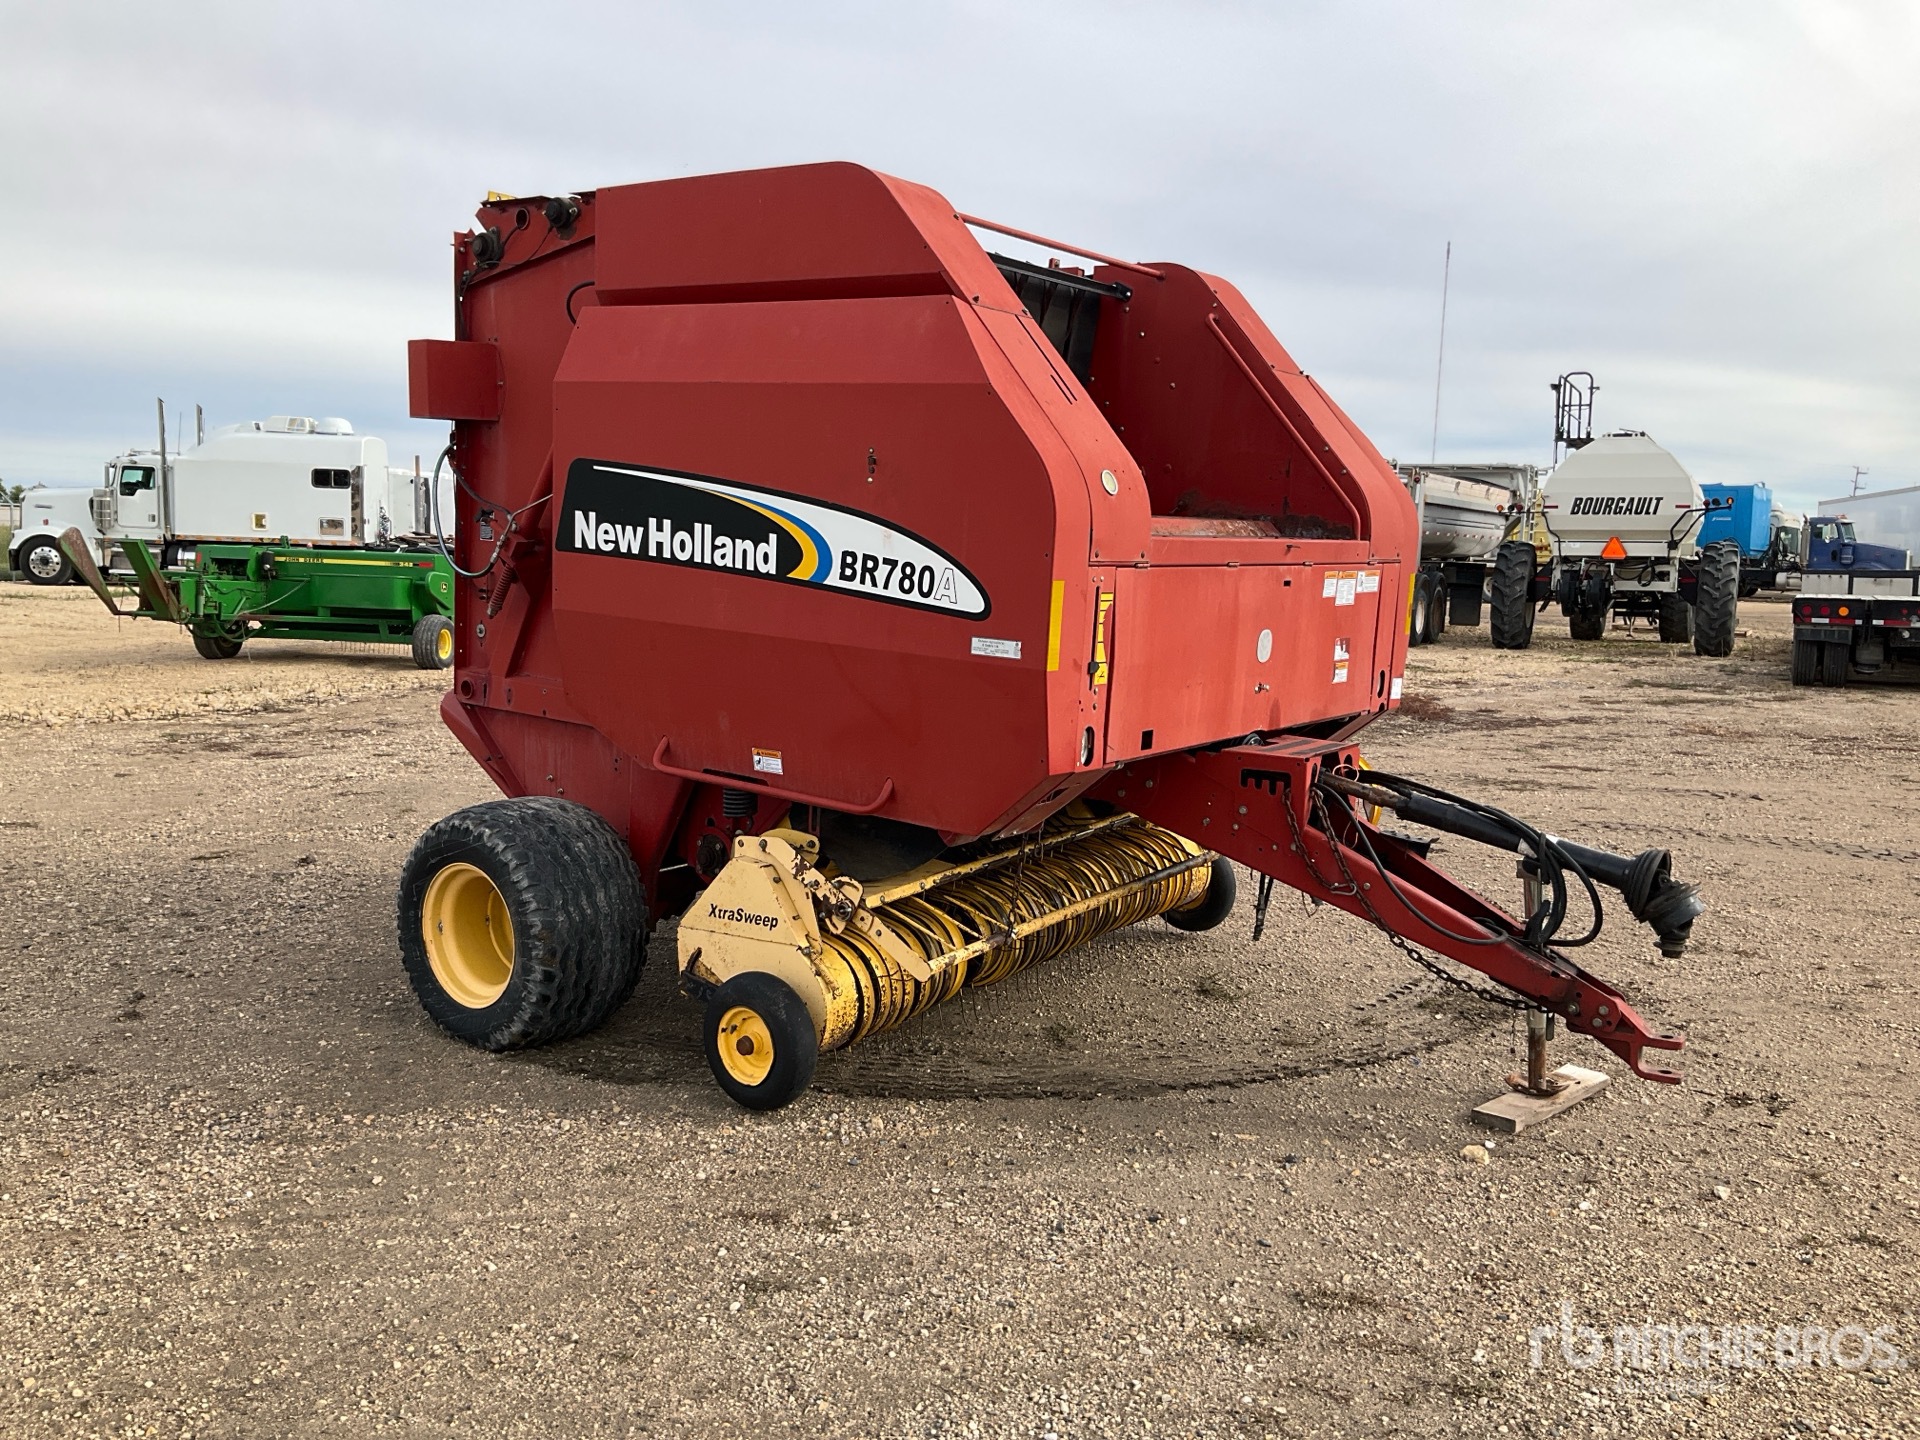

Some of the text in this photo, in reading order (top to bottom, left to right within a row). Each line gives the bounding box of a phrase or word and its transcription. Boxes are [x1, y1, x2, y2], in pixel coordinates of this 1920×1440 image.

[1570, 496, 1664, 516] BOURGAULT
[574, 510, 778, 575] New Holland
[838, 549, 958, 605] BR780A
[708, 903, 779, 931] XtraSweep
